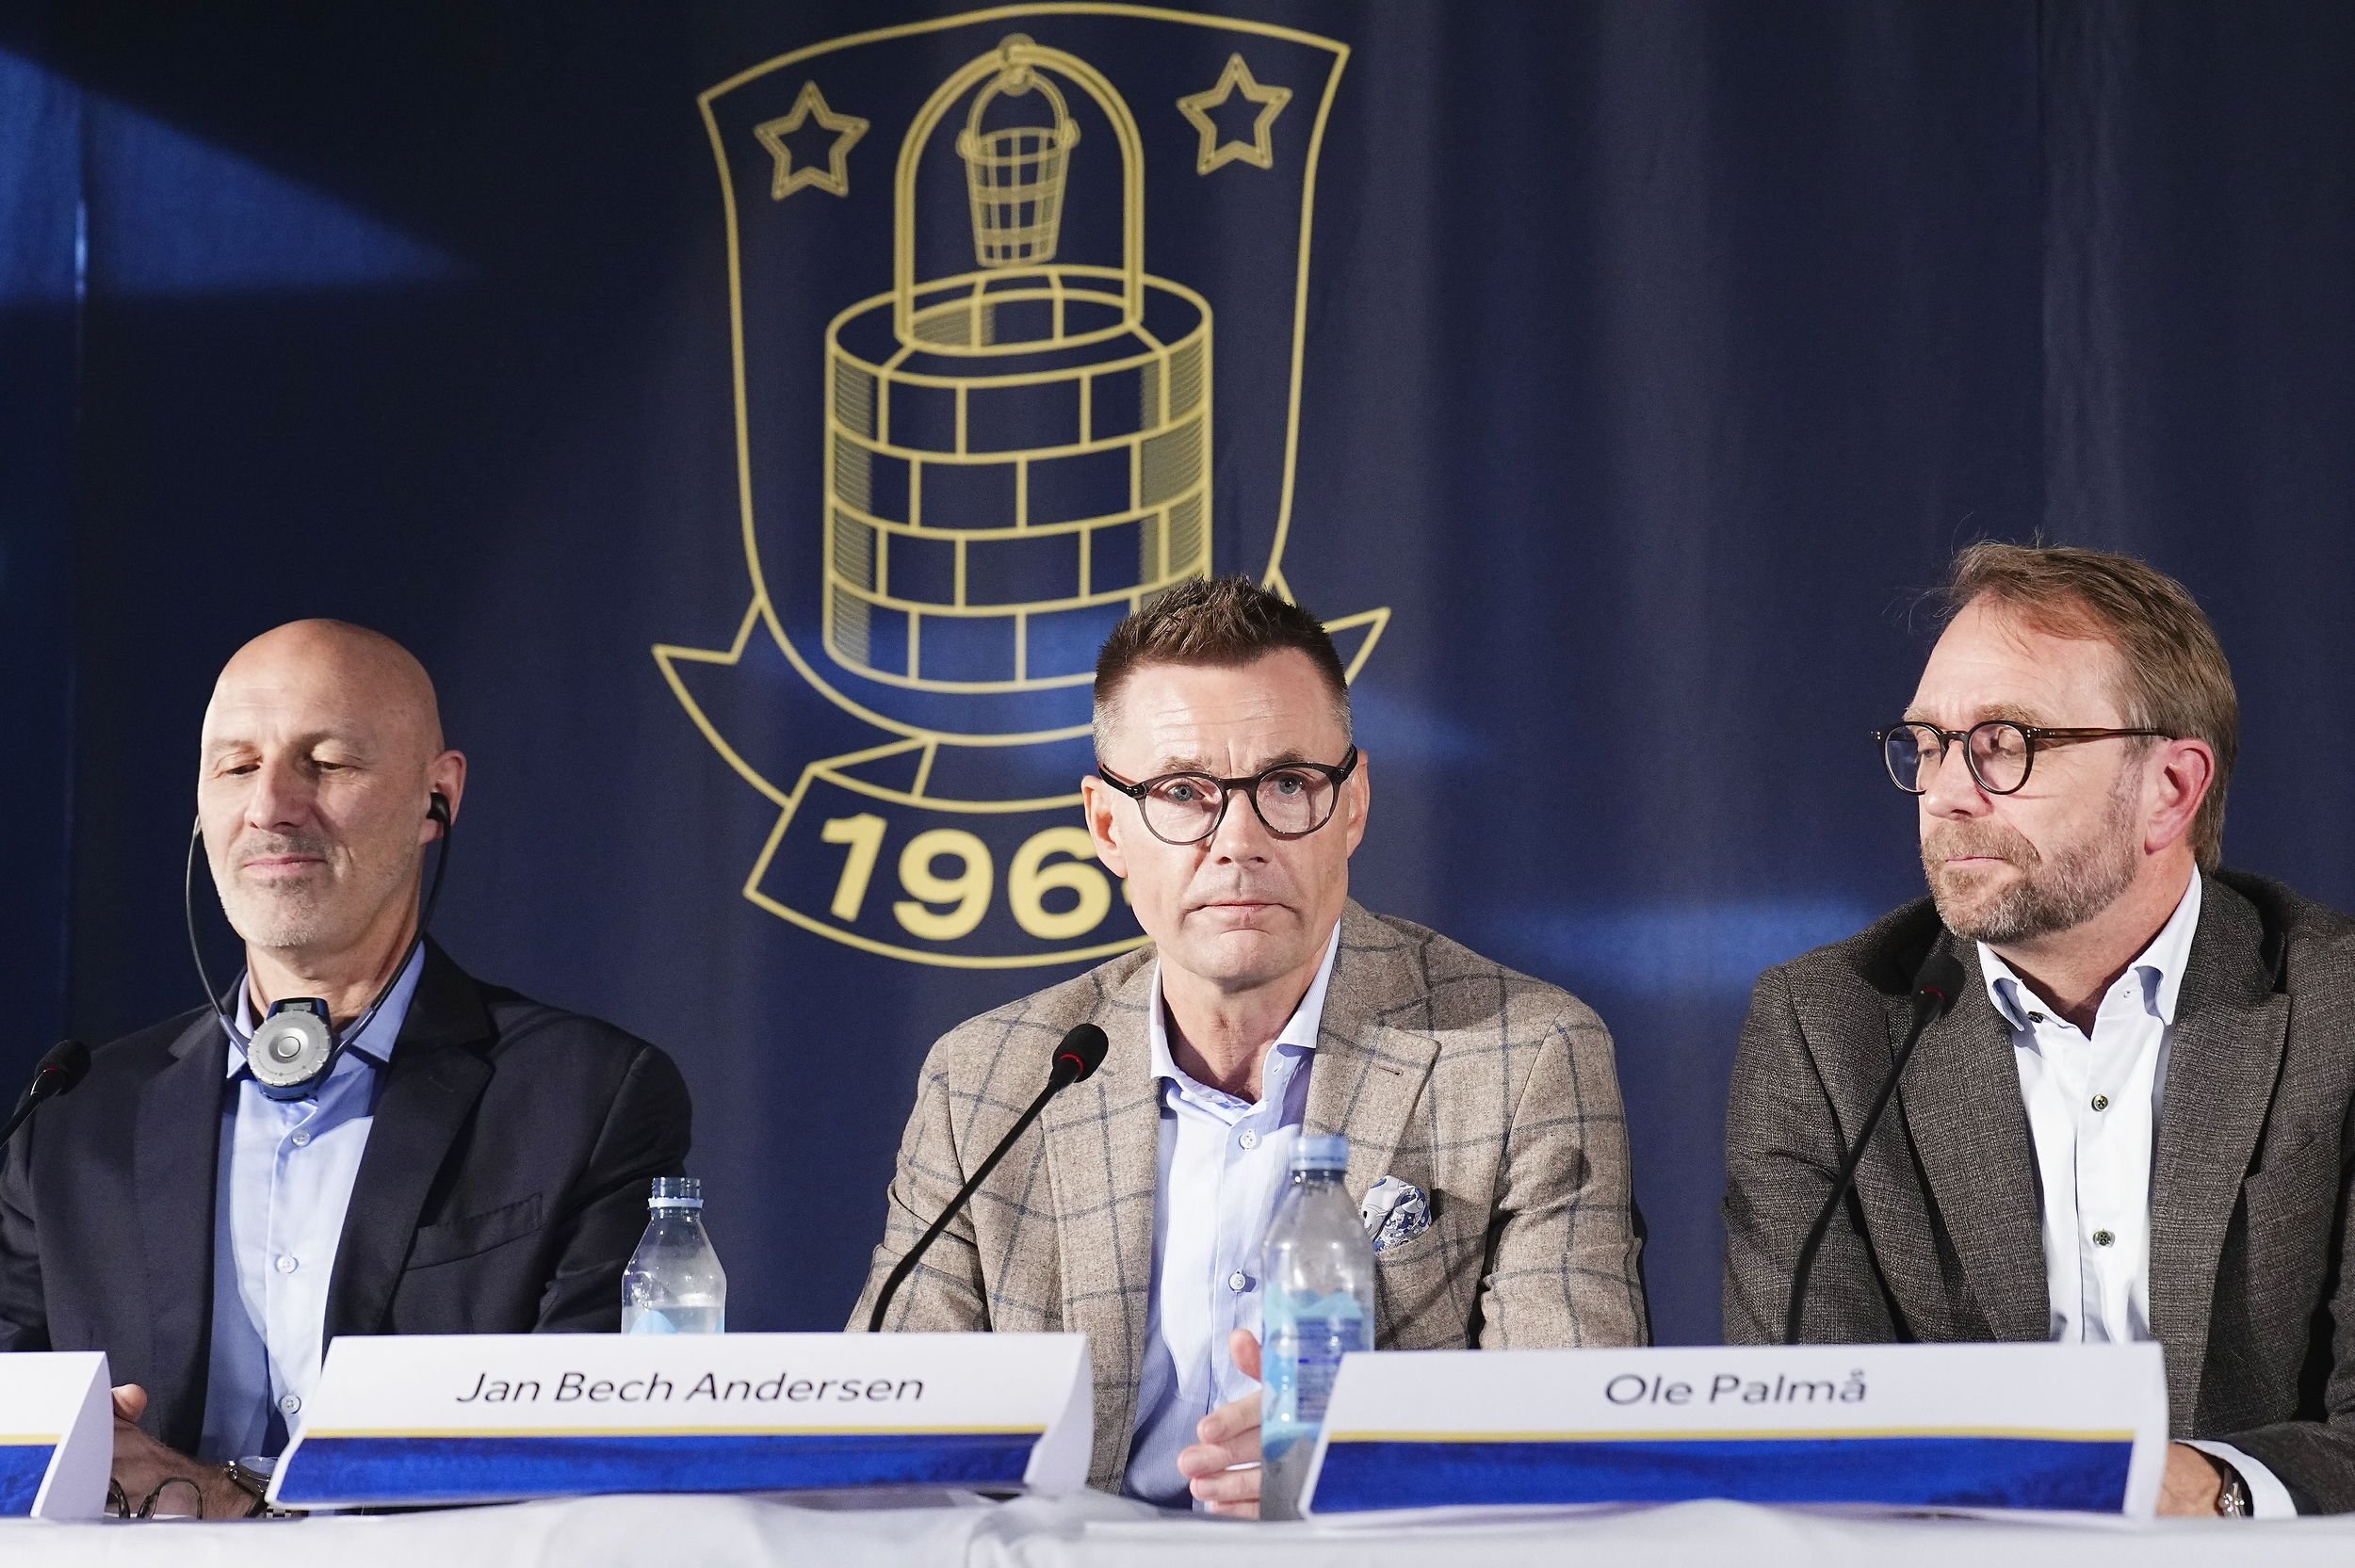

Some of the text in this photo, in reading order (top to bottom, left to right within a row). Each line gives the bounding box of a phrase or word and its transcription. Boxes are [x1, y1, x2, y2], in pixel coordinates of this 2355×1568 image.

[821, 814, 1129, 940] 196
[456, 1372, 924, 1403] Jan Bech Andersen
[1605, 1370, 1867, 1405] Ole Palmå
